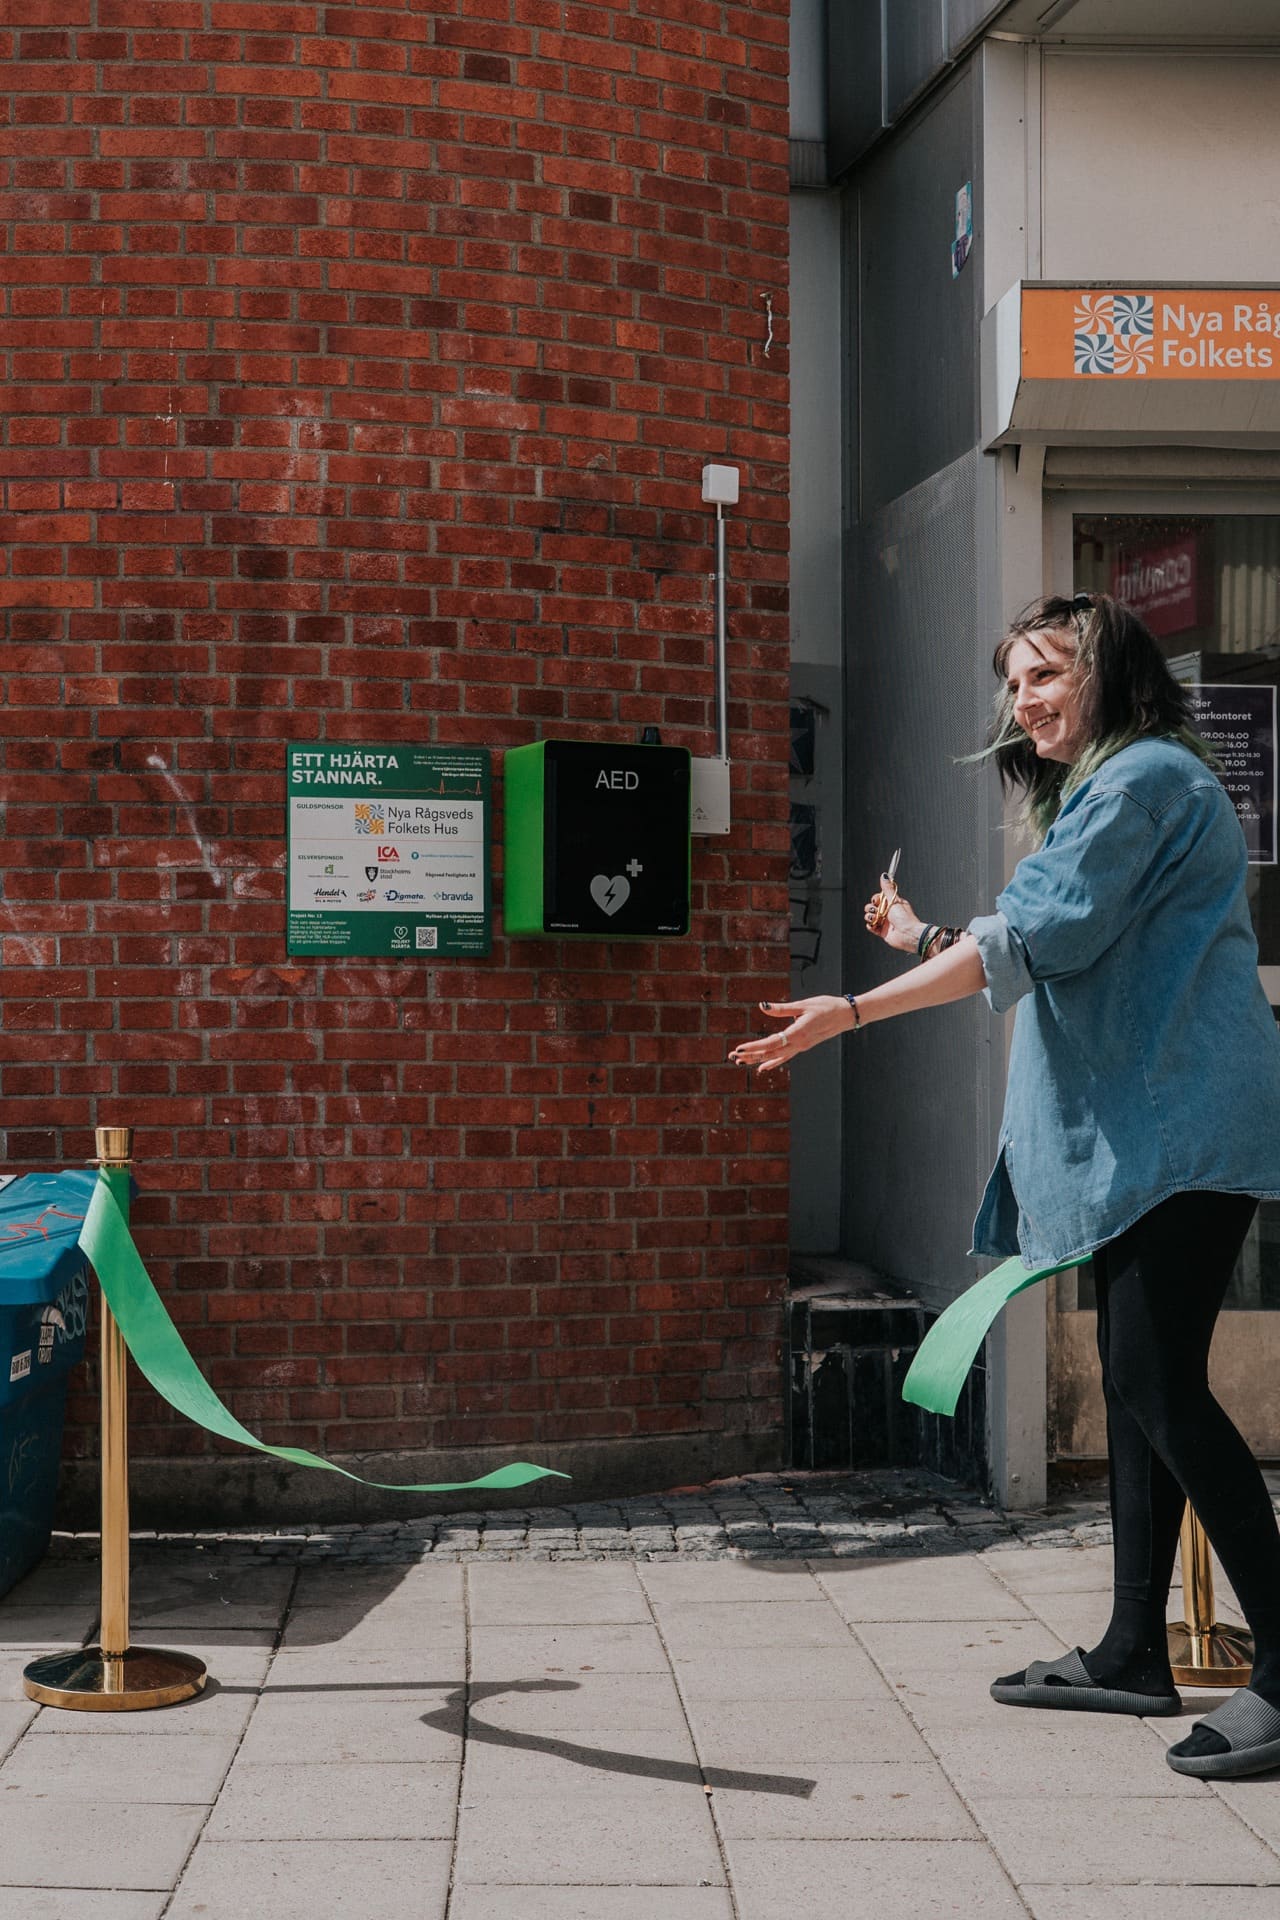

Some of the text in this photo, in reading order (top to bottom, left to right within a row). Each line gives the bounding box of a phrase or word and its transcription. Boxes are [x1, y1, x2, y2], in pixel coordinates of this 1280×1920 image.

[1163, 304, 1223, 338] Nya
[1162, 339, 1273, 368] Folkets
[1192, 710, 1252, 722] garkontoret
[292, 751, 399, 768] ETT HJÄRTA
[292, 770, 382, 785] STANNAR.
[595, 770, 639, 790] AED
[388, 807, 474, 822] Nya Rågsveds
[388, 822, 459, 835] Folkets Hus
[377, 846, 399, 858] ICA
[314, 888, 340, 896] Hendel
[441, 891, 474, 901] bravida
